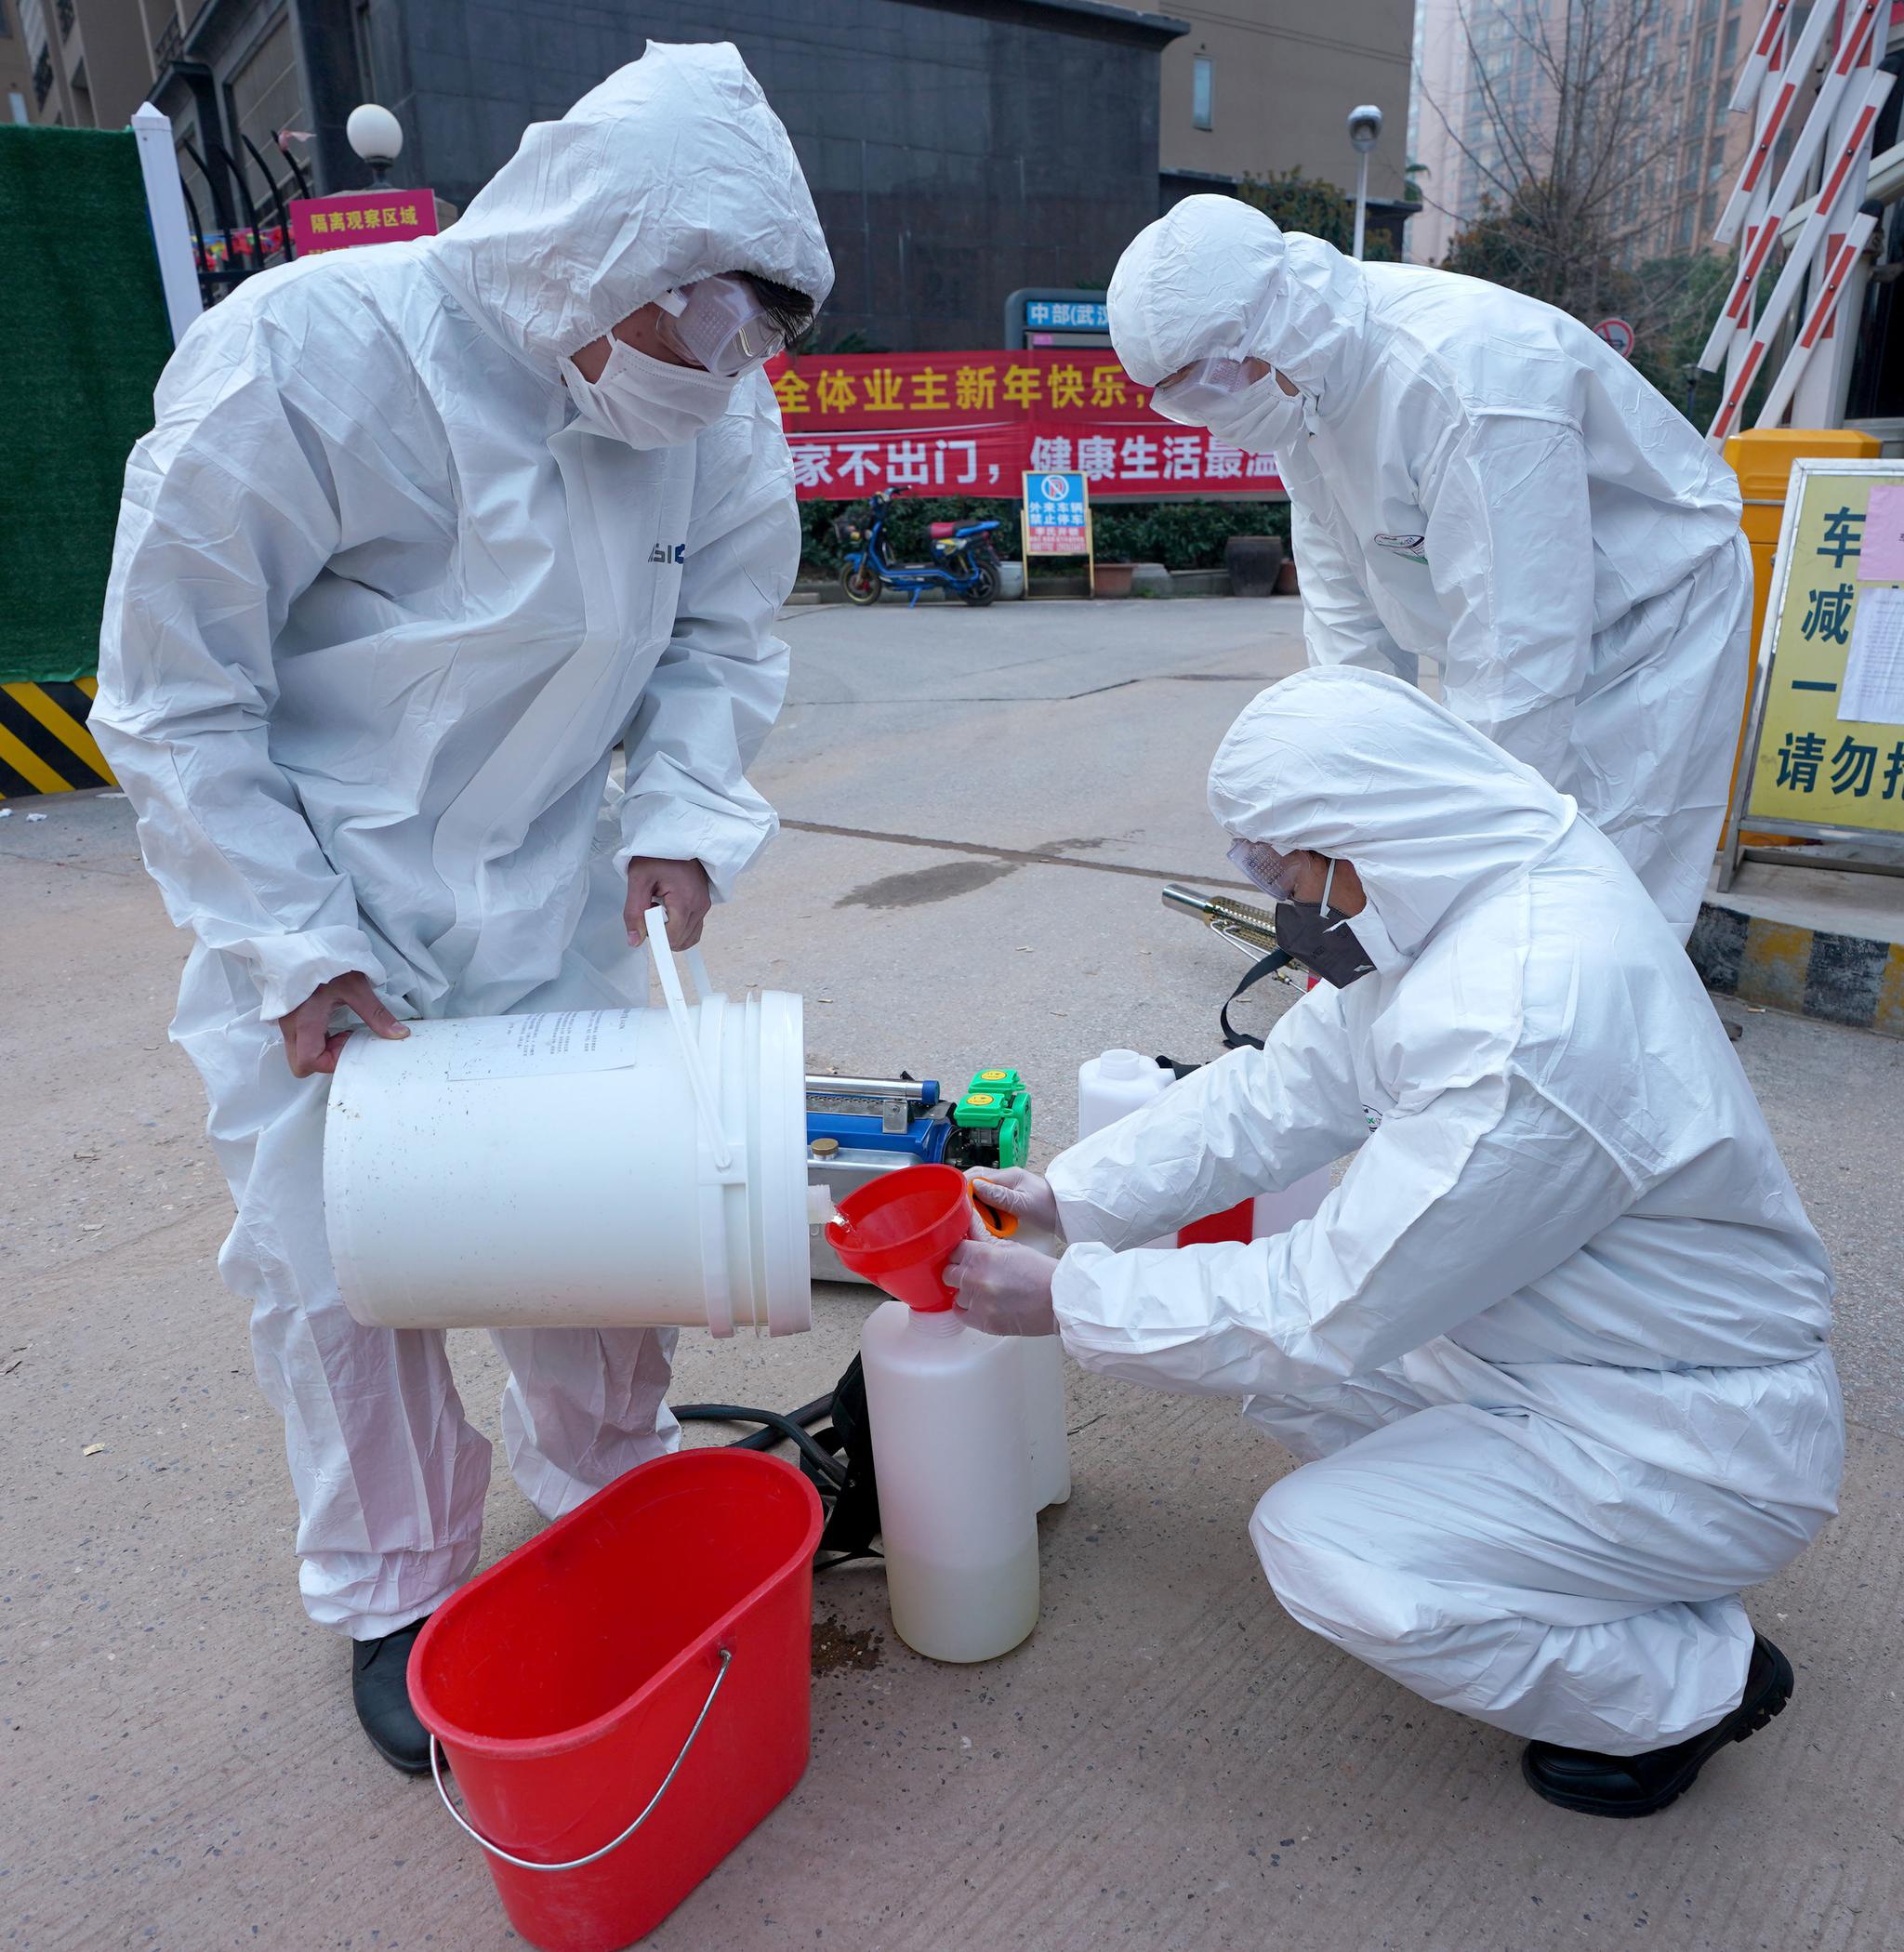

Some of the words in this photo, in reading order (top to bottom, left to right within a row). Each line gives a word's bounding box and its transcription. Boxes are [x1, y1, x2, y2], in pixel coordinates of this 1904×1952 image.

[310, 205, 418, 233] 隔离观察区域
[1801, 584, 1854, 645] 减
